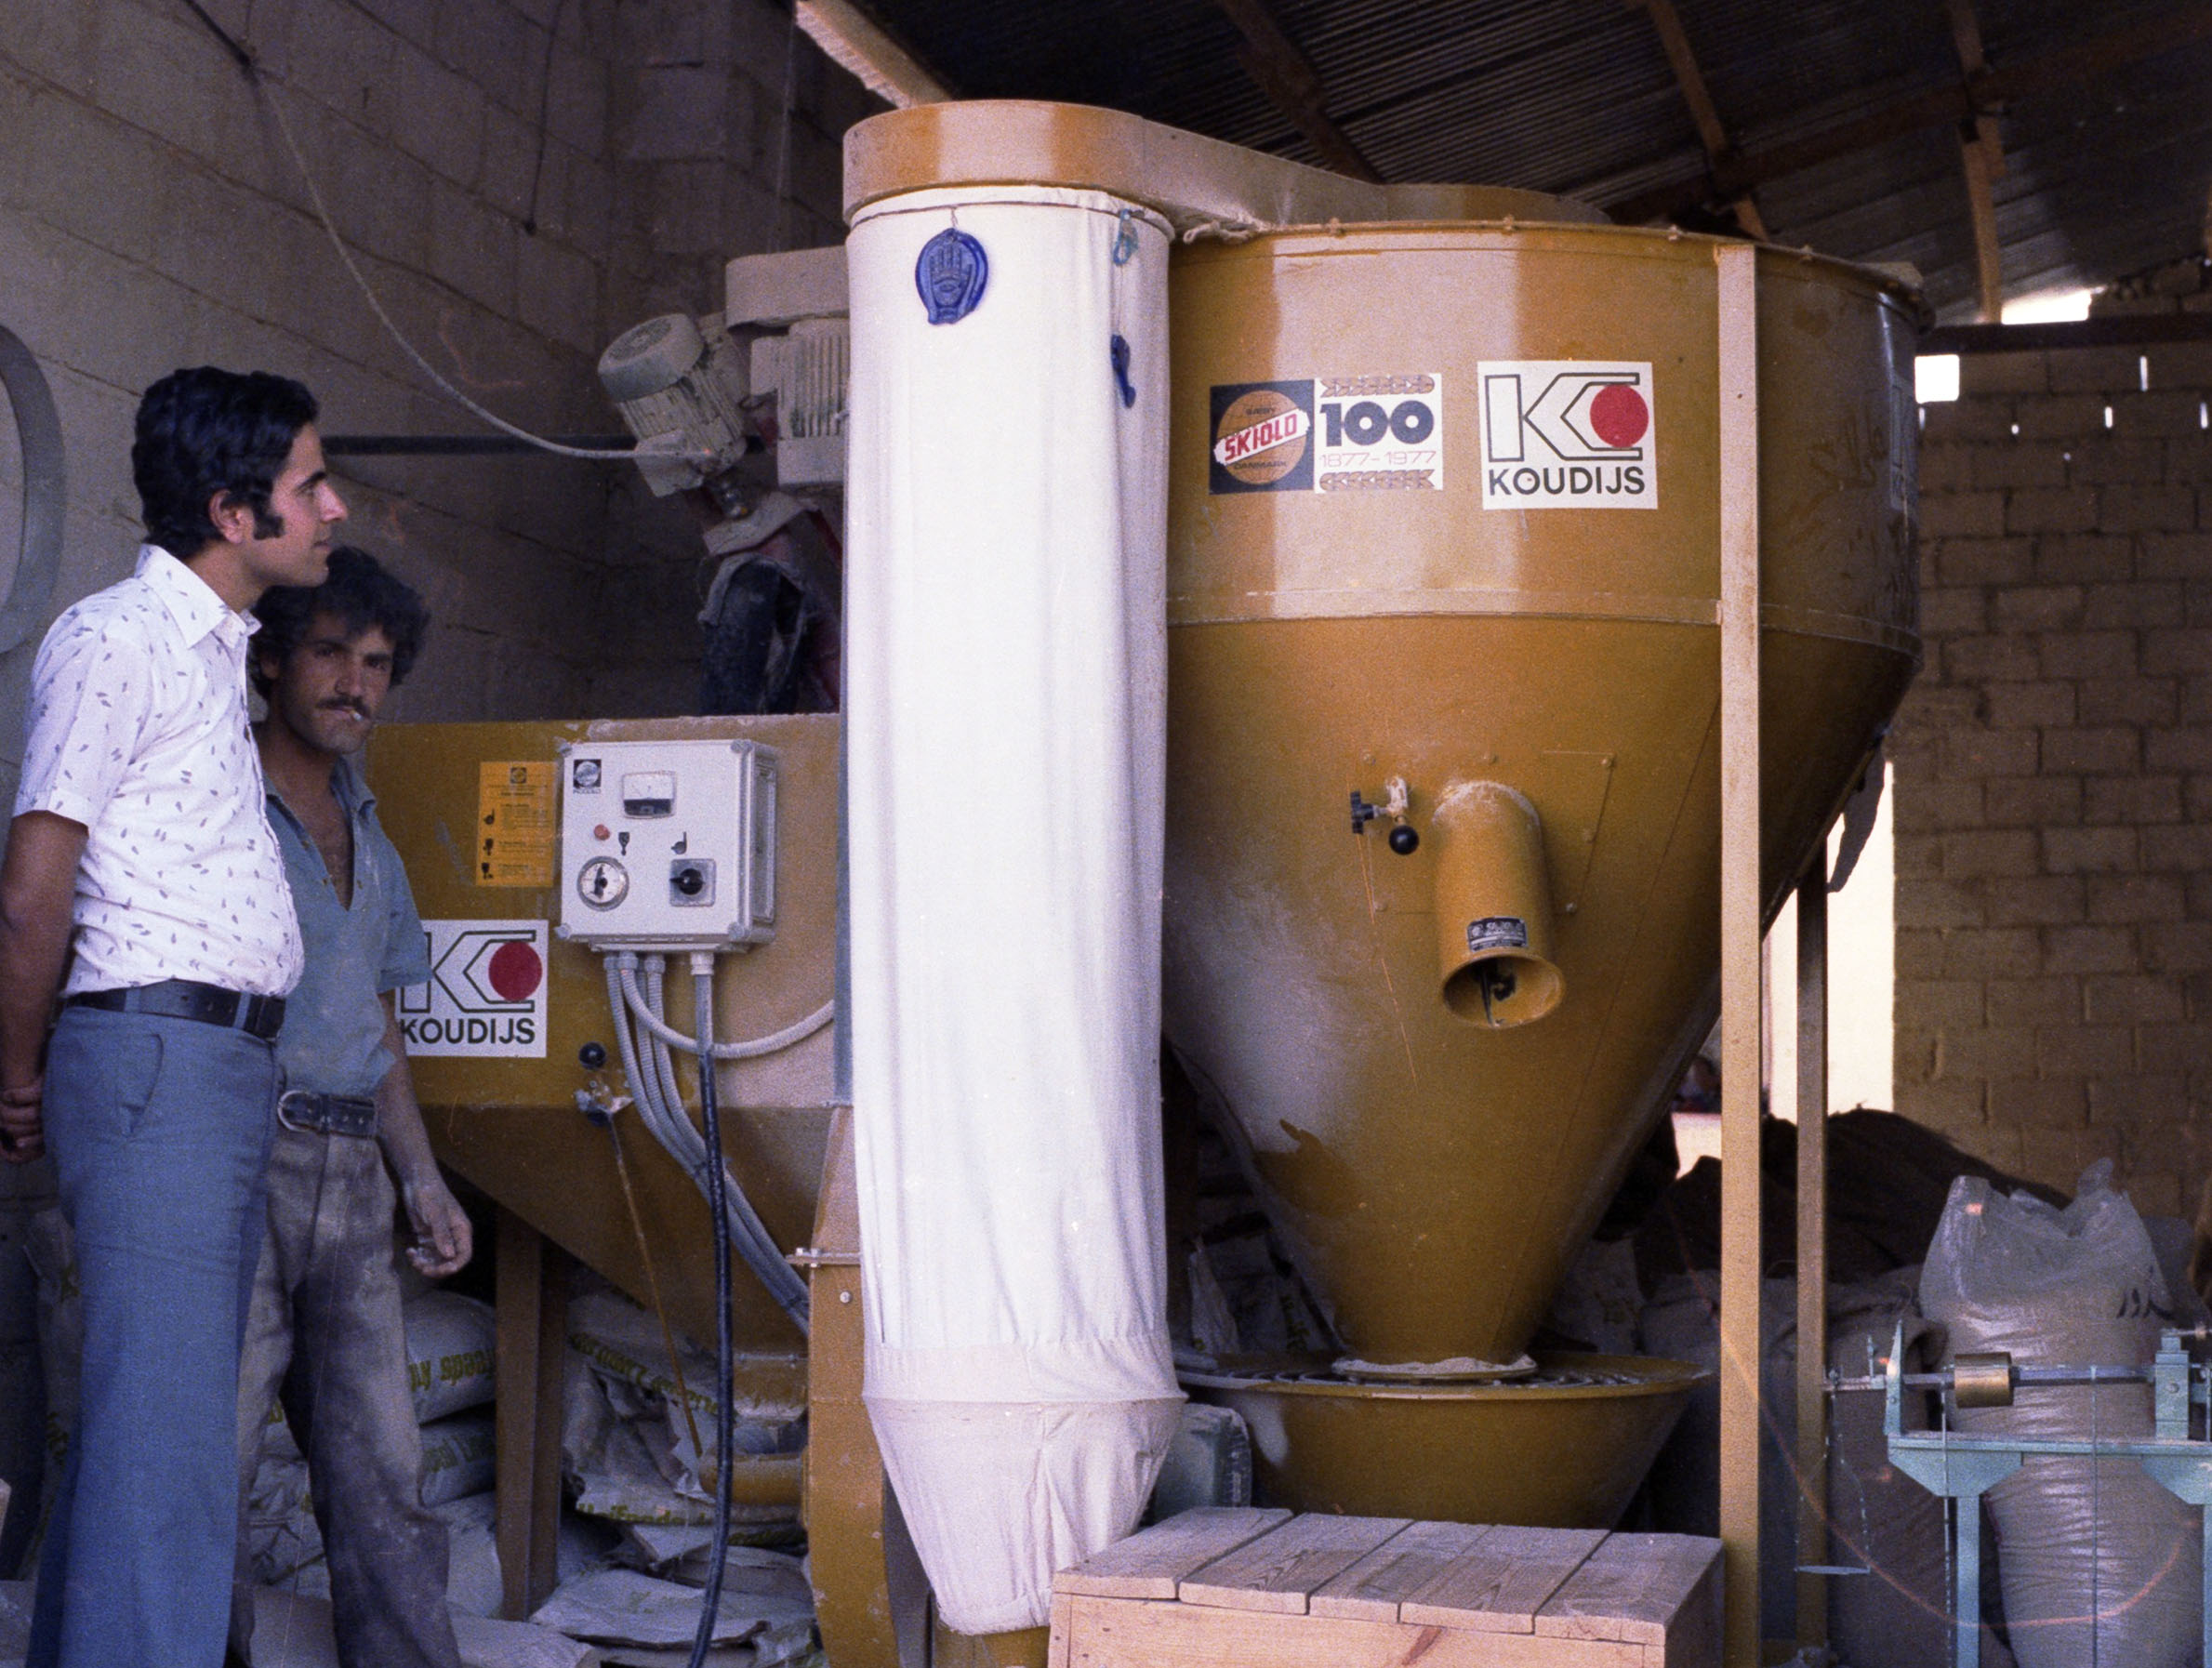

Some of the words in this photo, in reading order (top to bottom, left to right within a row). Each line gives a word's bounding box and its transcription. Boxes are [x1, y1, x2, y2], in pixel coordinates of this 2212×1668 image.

[1319, 400, 1435, 447] 100
[1319, 450, 1437, 468] 1877-1977
[1489, 467, 1646, 496] KOUDIJS
[400, 1017, 536, 1044] KOUDIJS
